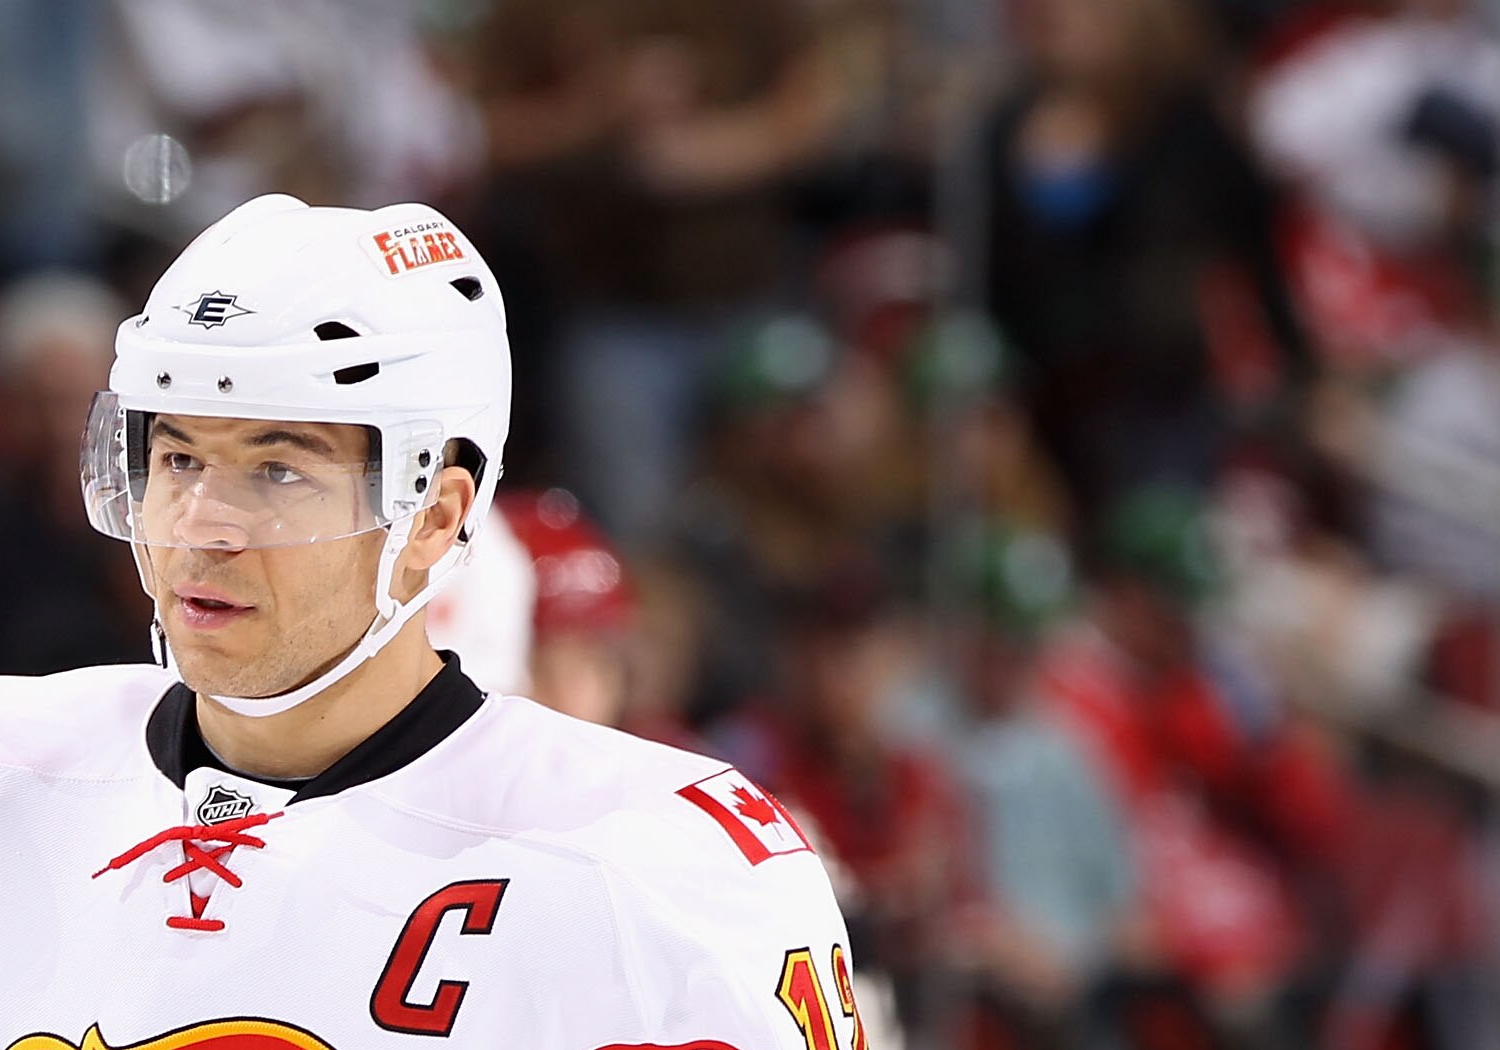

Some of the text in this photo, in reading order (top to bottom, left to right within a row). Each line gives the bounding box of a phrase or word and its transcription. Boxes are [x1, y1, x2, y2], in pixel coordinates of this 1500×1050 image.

[394, 222, 445, 238] CALGARY
[373, 231, 464, 275] FLAMES
[202, 799, 248, 821] NHL
[369, 878, 511, 1038] C
